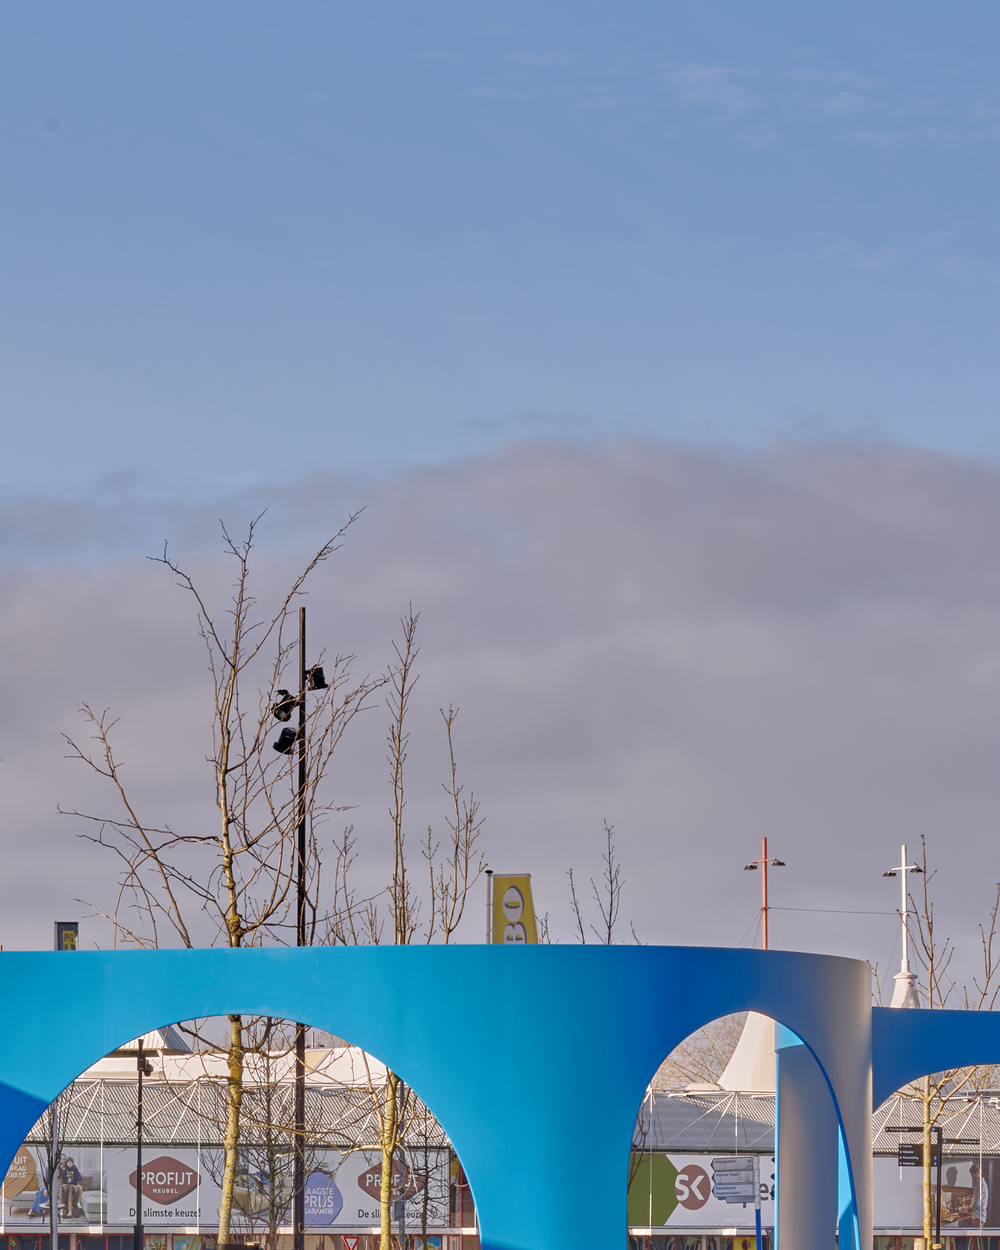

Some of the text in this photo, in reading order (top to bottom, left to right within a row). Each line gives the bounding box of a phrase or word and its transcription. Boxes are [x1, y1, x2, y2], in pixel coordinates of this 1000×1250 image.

[14, 1156, 27, 1165] UIT
[141, 1172, 193, 1185] PROFIJT
[675, 1174, 705, 1201] SK
[304, 1195, 334, 1208] PRIJS
[143, 1208, 173, 1218] slimste
[358, 1209, 370, 1218] De
